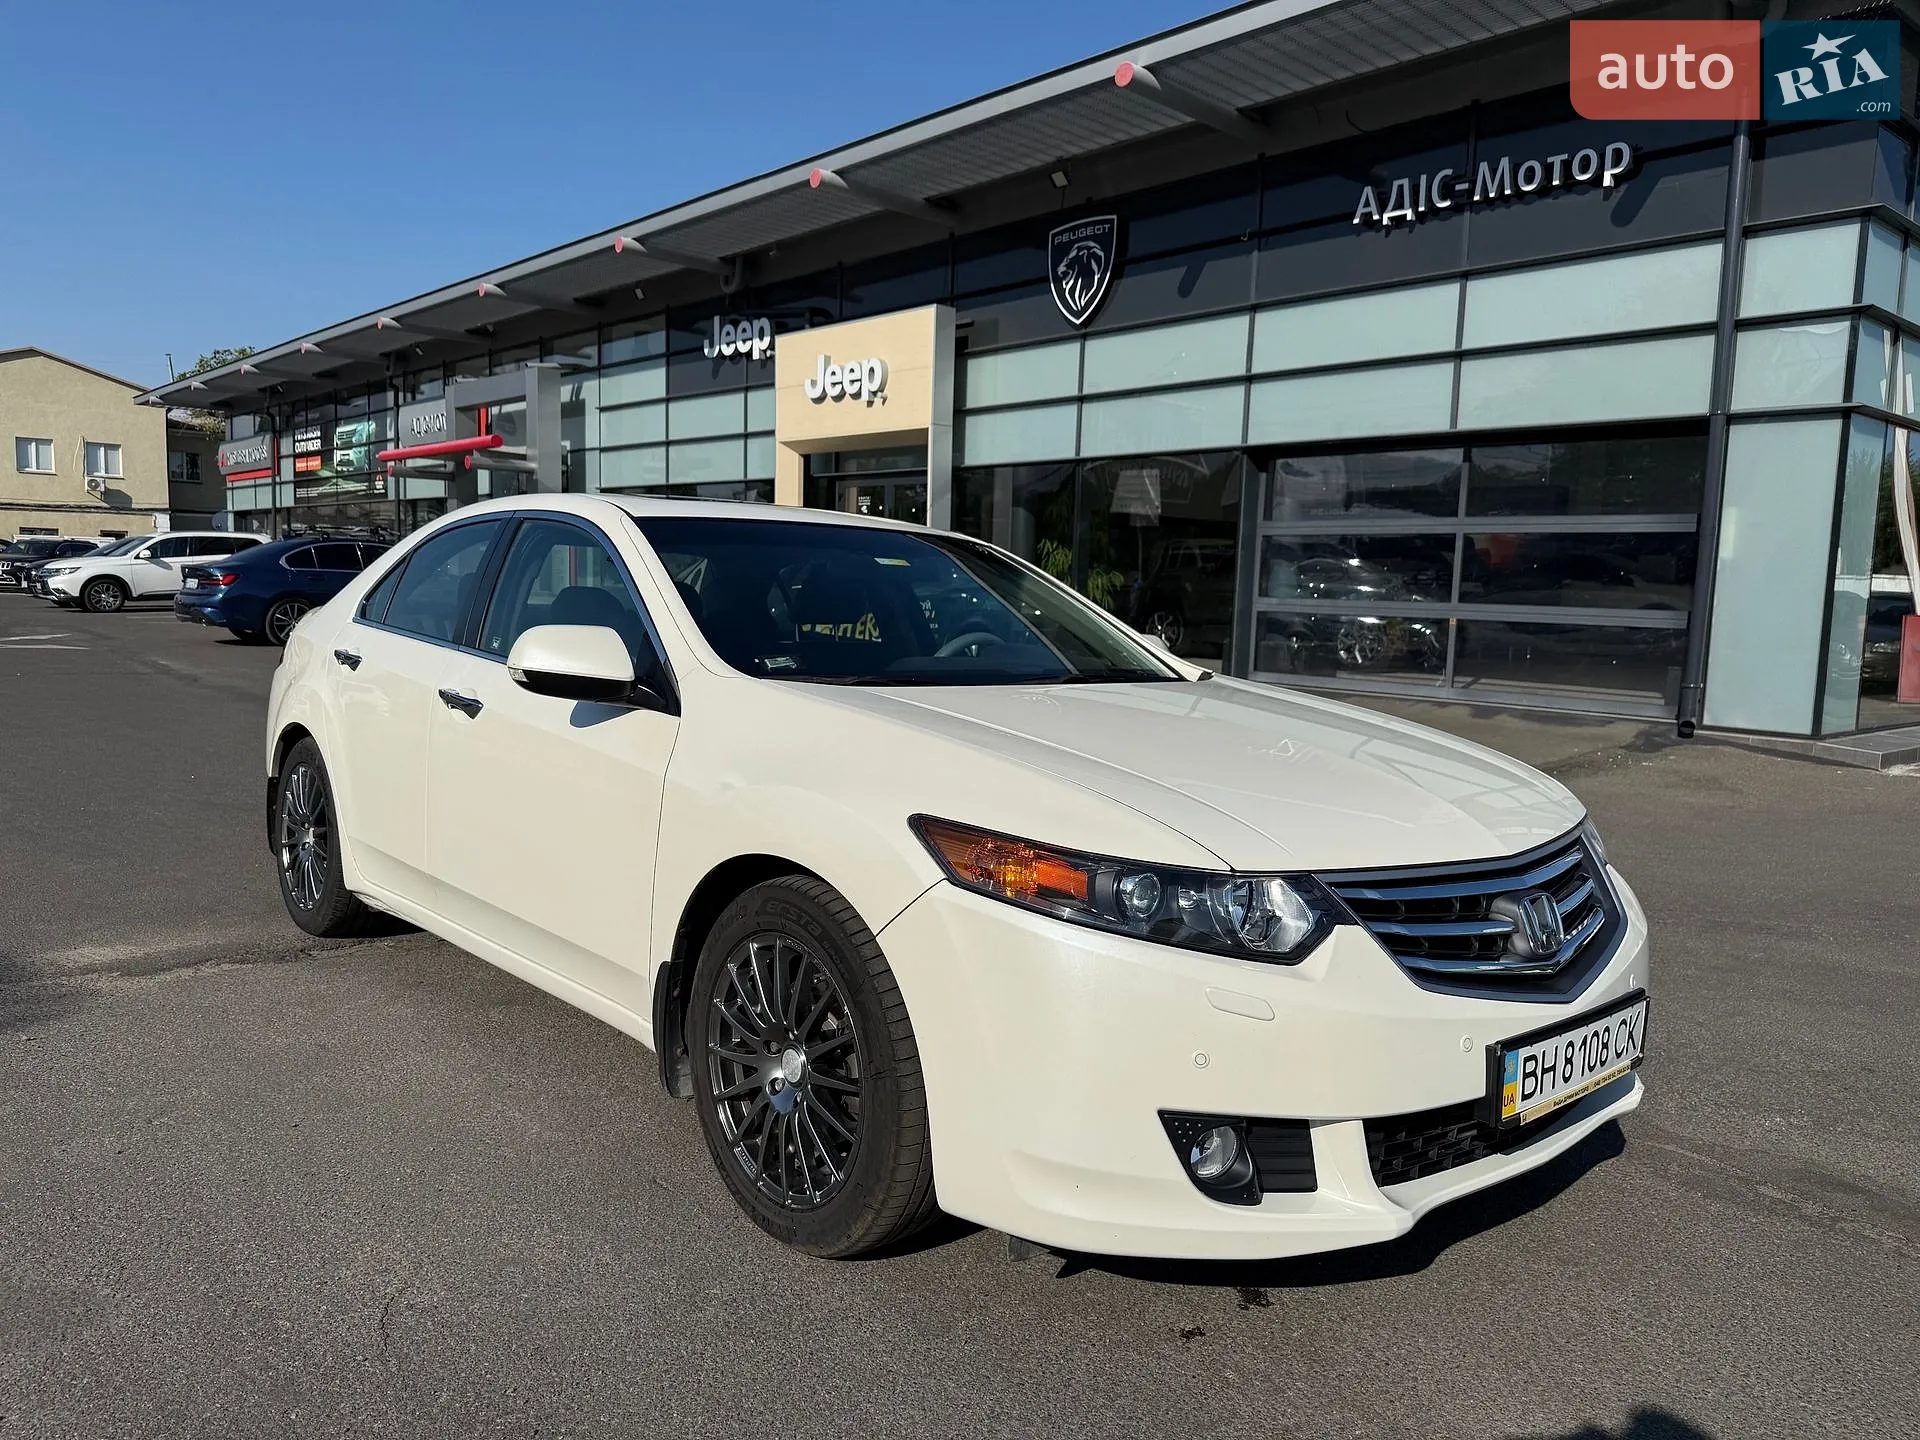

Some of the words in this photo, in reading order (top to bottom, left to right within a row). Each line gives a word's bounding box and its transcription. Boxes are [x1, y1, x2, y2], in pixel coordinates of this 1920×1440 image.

[1352, 142, 1631, 226] АДІС-Мотор
[1054, 224, 1111, 246] PEUGEOT
[703, 315, 772, 361] Jeep
[804, 354, 887, 404] Jeep
[1521, 1044, 1558, 1103] BH
[1562, 1024, 1611, 1084] 8108
[1614, 1008, 1641, 1060] CK
[1503, 1092, 1516, 1109] UA
